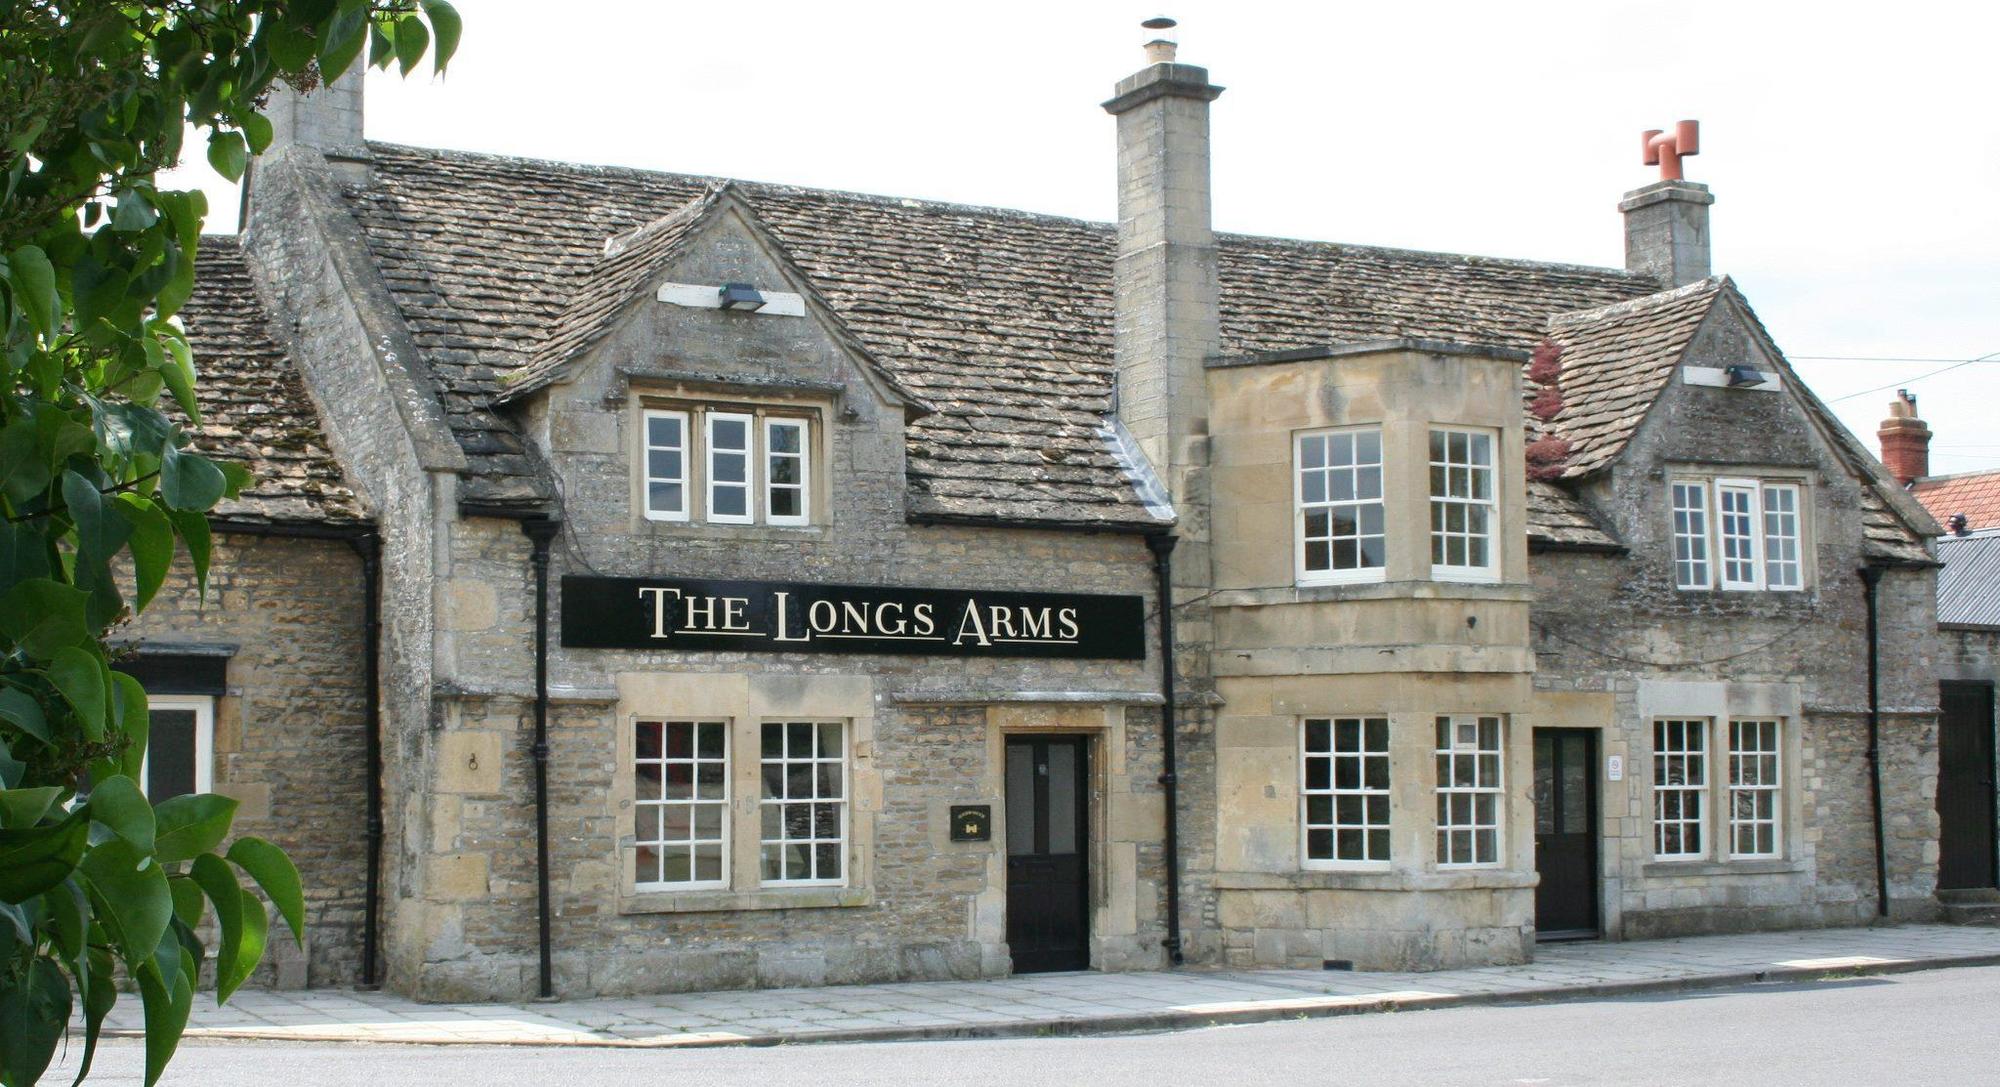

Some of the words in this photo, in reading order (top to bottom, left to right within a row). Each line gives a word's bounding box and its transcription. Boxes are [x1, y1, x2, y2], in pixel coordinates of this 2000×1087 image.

[638, 587, 750, 638] THE
[773, 591, 935, 642] LONGS
[952, 598, 1079, 646] ARMS
